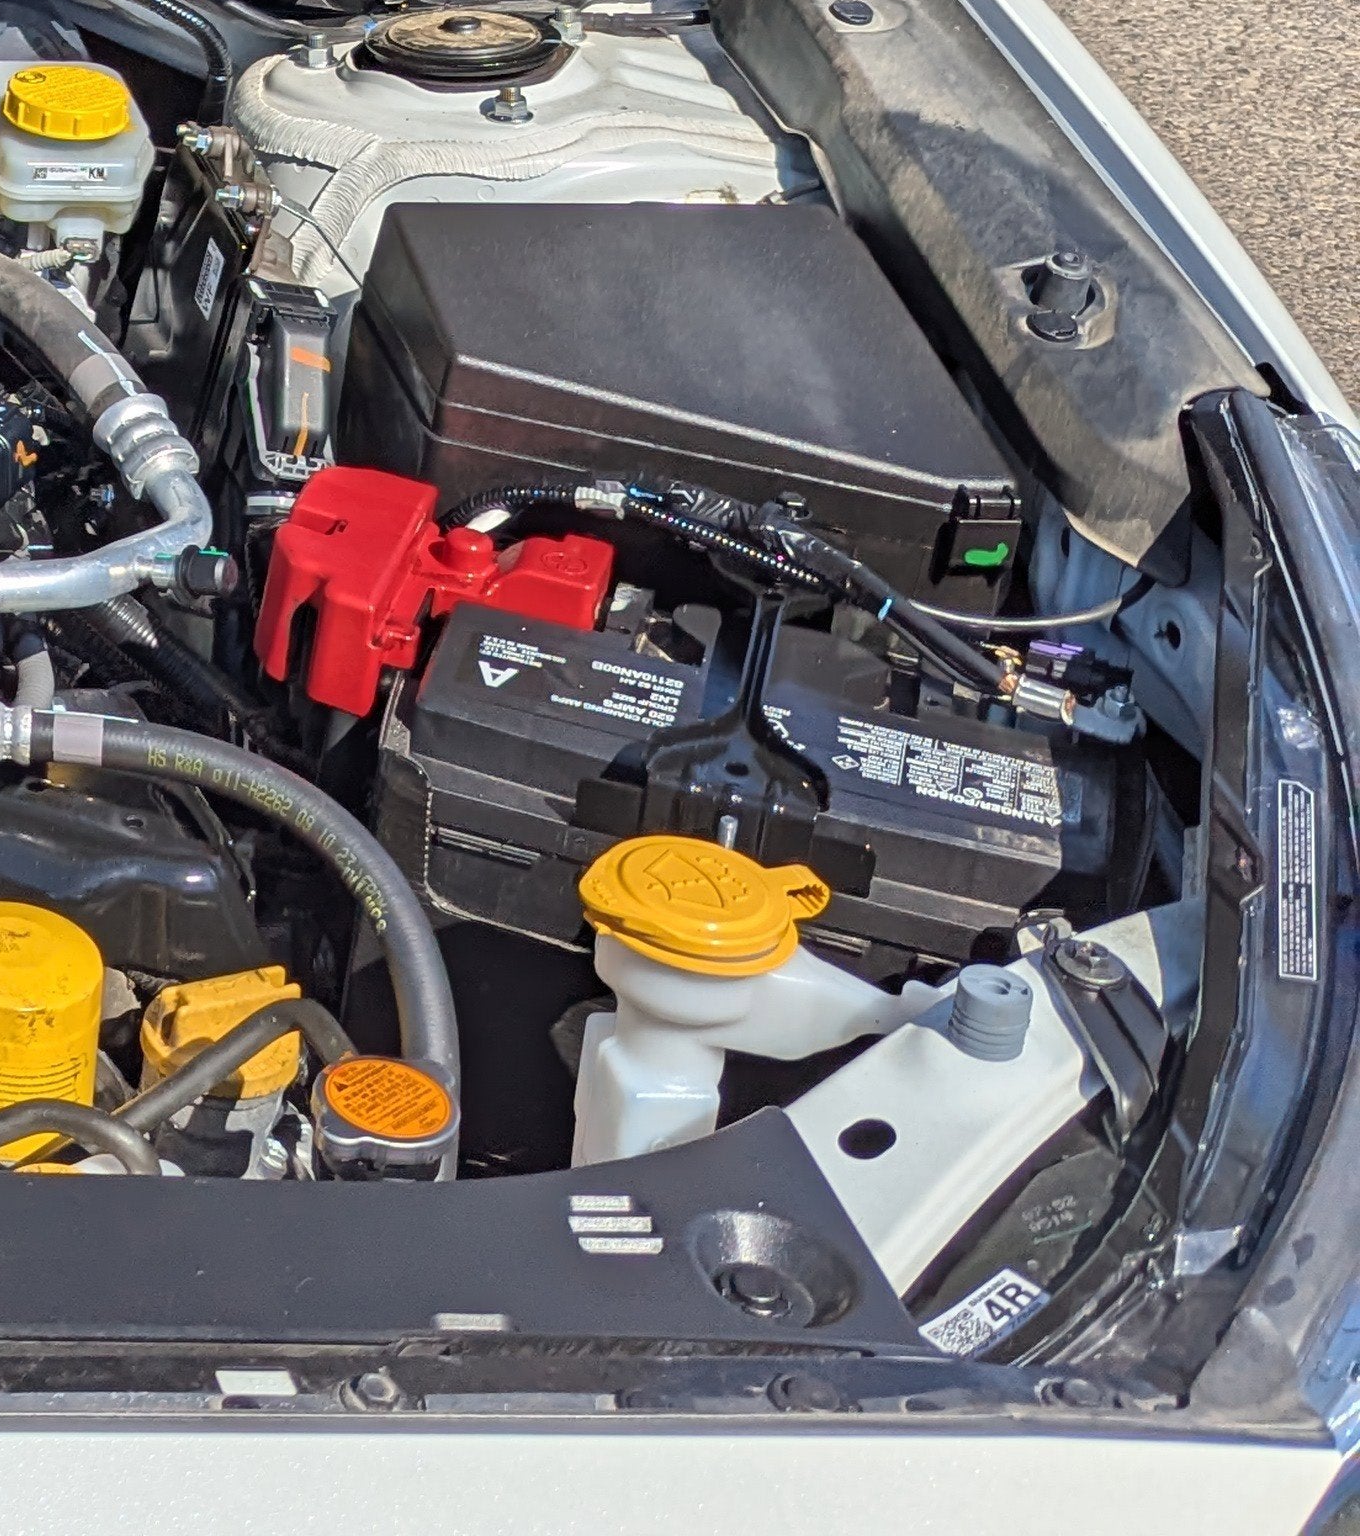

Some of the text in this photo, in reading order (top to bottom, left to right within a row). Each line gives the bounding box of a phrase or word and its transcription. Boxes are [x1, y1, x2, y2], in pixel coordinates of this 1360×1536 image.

[602, 698, 647, 716] AMPS
[915, 785, 1045, 825] DANGER/POISON
[983, 1282, 1039, 1321] 4R
